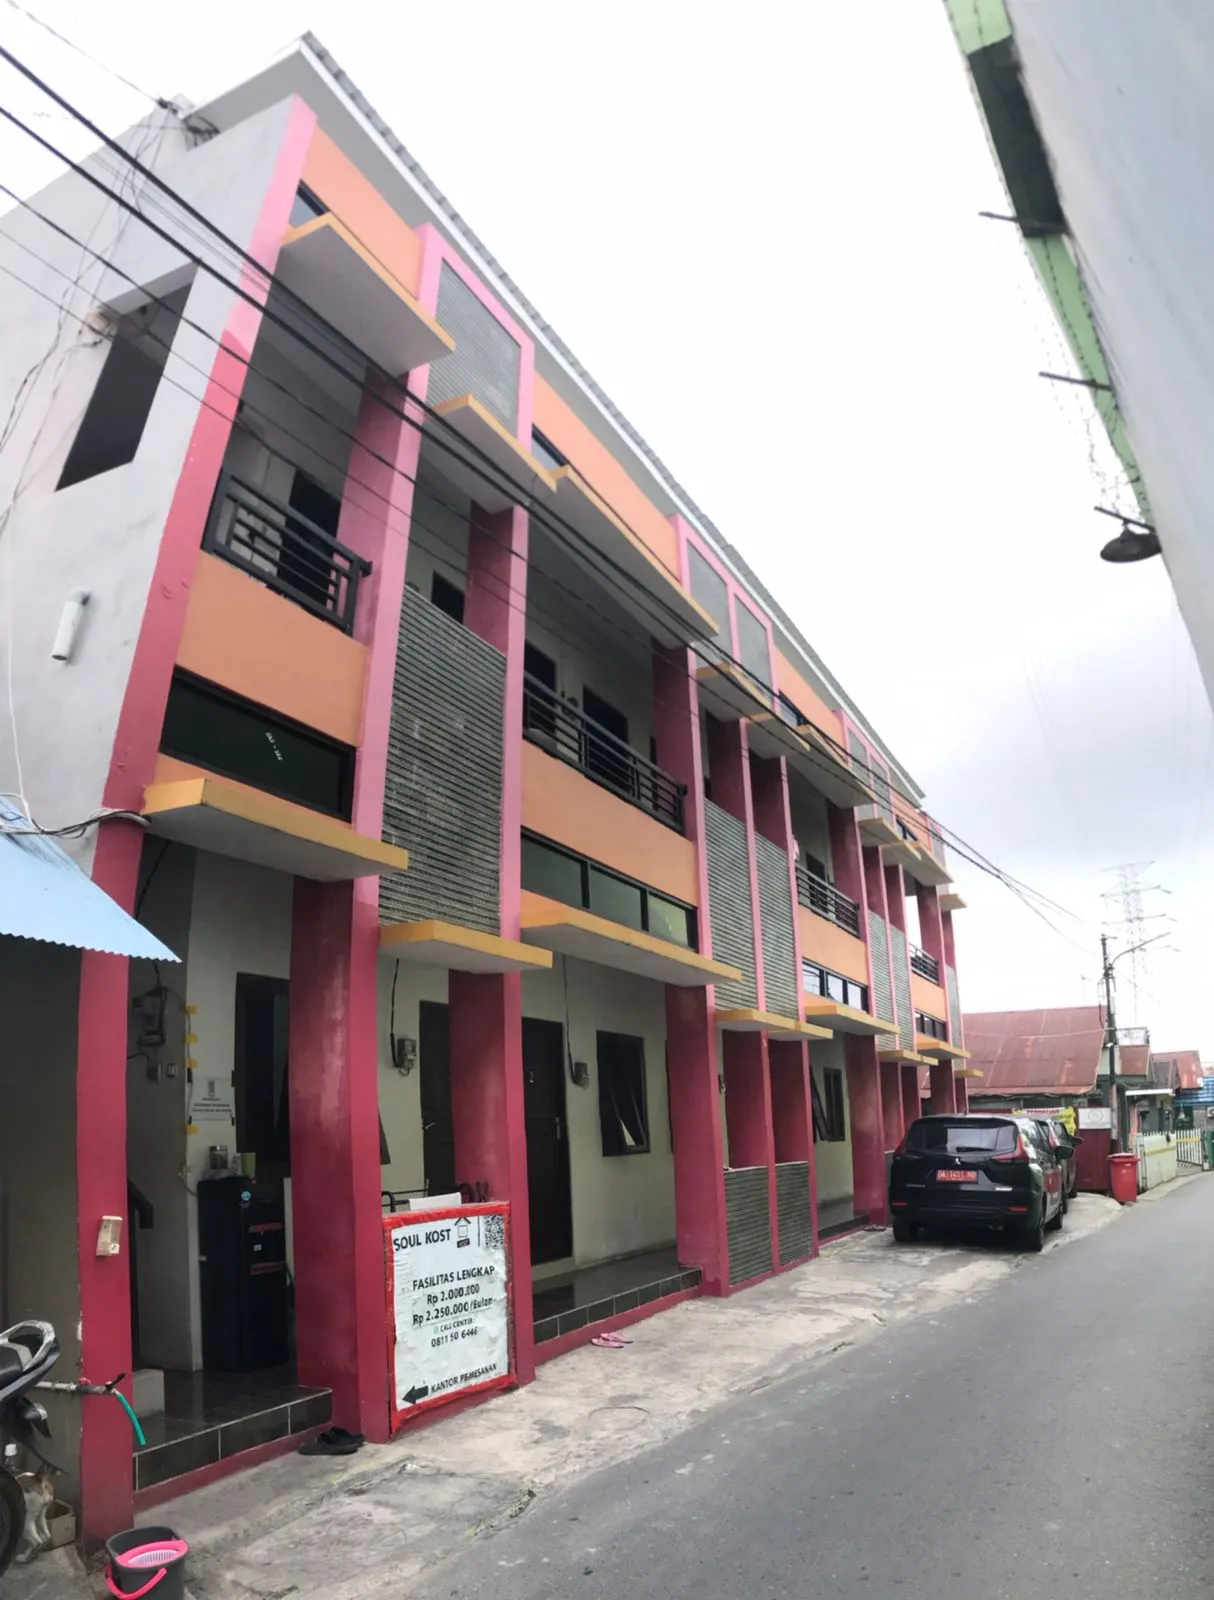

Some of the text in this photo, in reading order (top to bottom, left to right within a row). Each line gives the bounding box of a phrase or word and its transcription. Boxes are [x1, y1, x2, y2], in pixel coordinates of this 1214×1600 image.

[393, 1233, 422, 1252] SOUL
[425, 1228, 452, 1245] KOST
[412, 1265, 496, 1291] FASILITAS LENGKAP
[427, 1283, 481, 1307] Rp 2.000.000
[412, 1314, 425, 1329] Rp
[440, 1323, 452, 1333] CALL
[431, 1335, 448, 1348] 0811
[450, 1331, 459, 1342] 50
[430, 1376, 459, 1393] KANTOR
